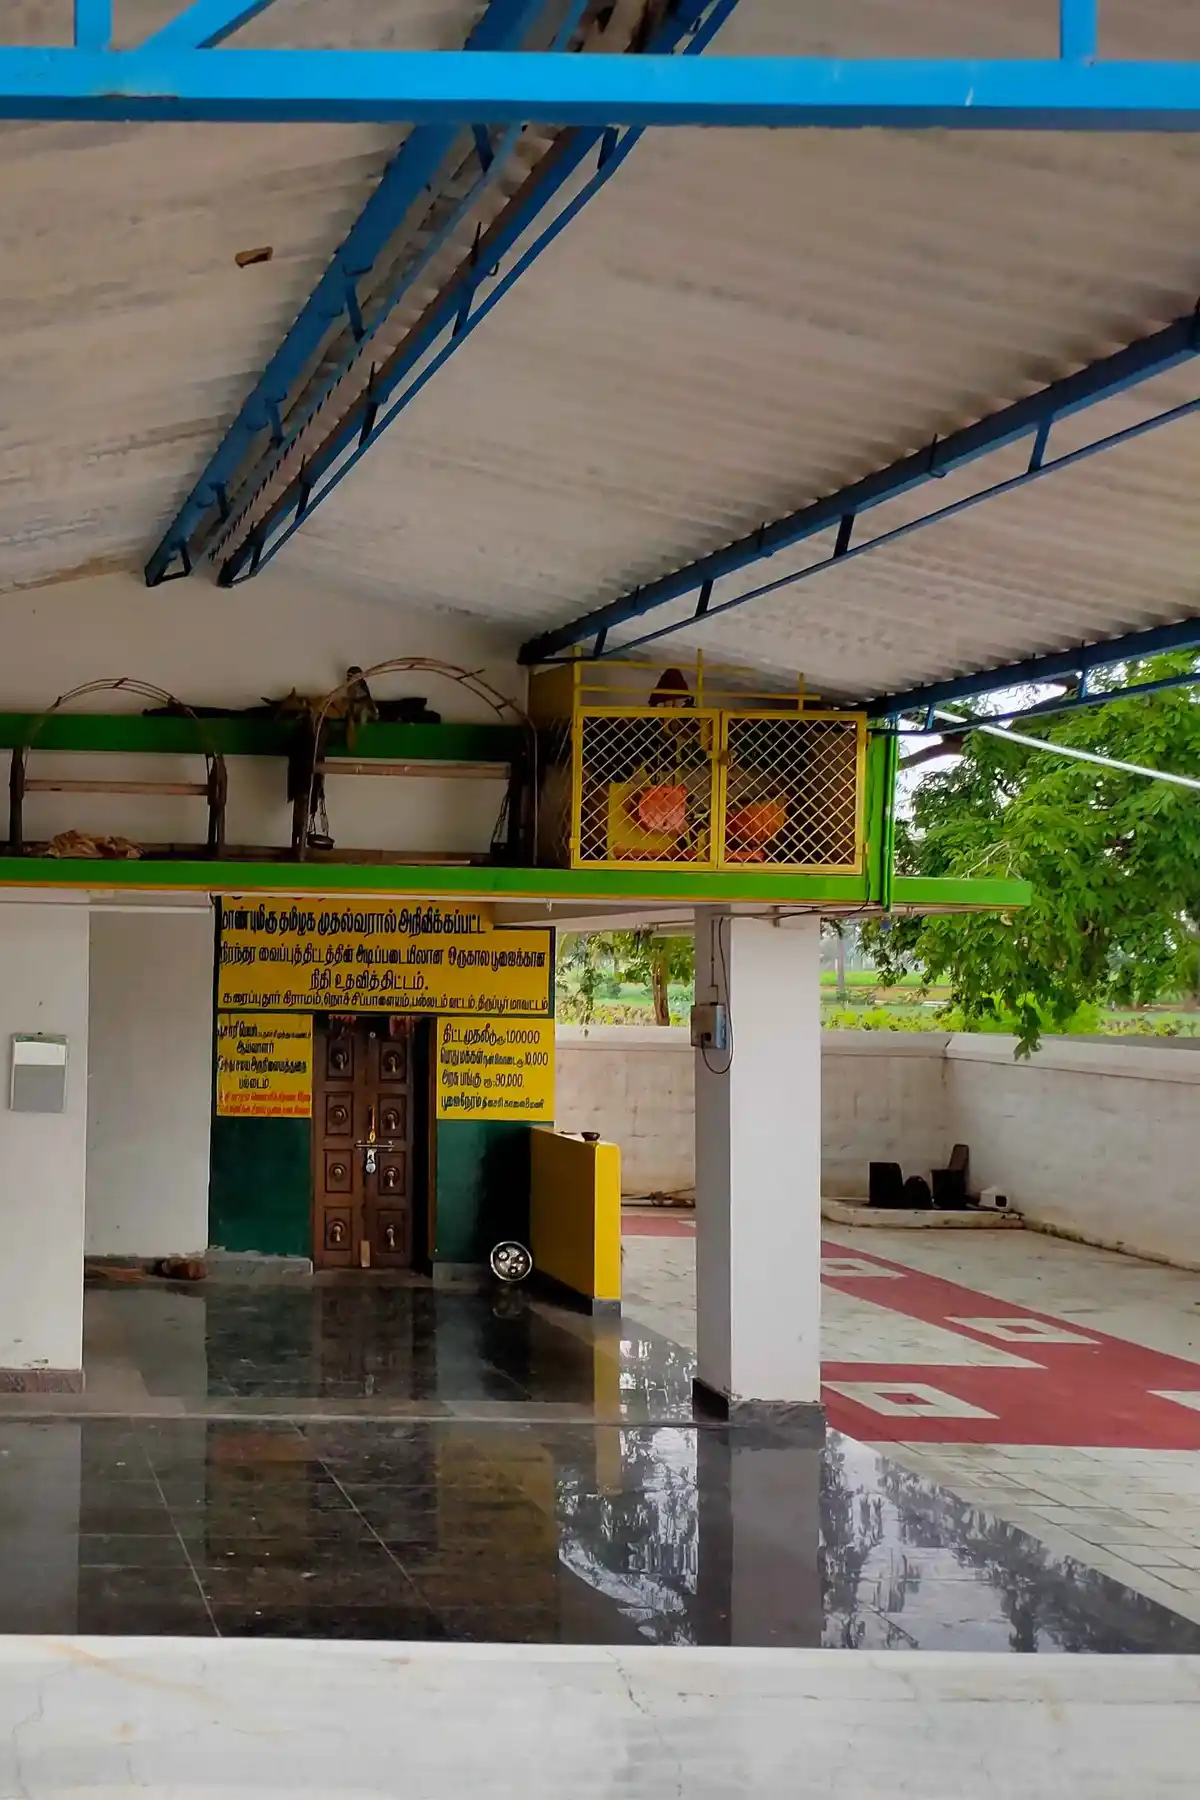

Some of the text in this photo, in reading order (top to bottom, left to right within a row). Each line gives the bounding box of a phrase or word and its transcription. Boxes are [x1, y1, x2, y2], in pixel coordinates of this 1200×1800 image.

[279, 906, 315, 936] தமிழக
[318, 908, 396, 937] முதல்வரால்
[398, 906, 486, 938] அறிவிக்கப்பட்ட
[309, 968, 331, 990] நிதி
